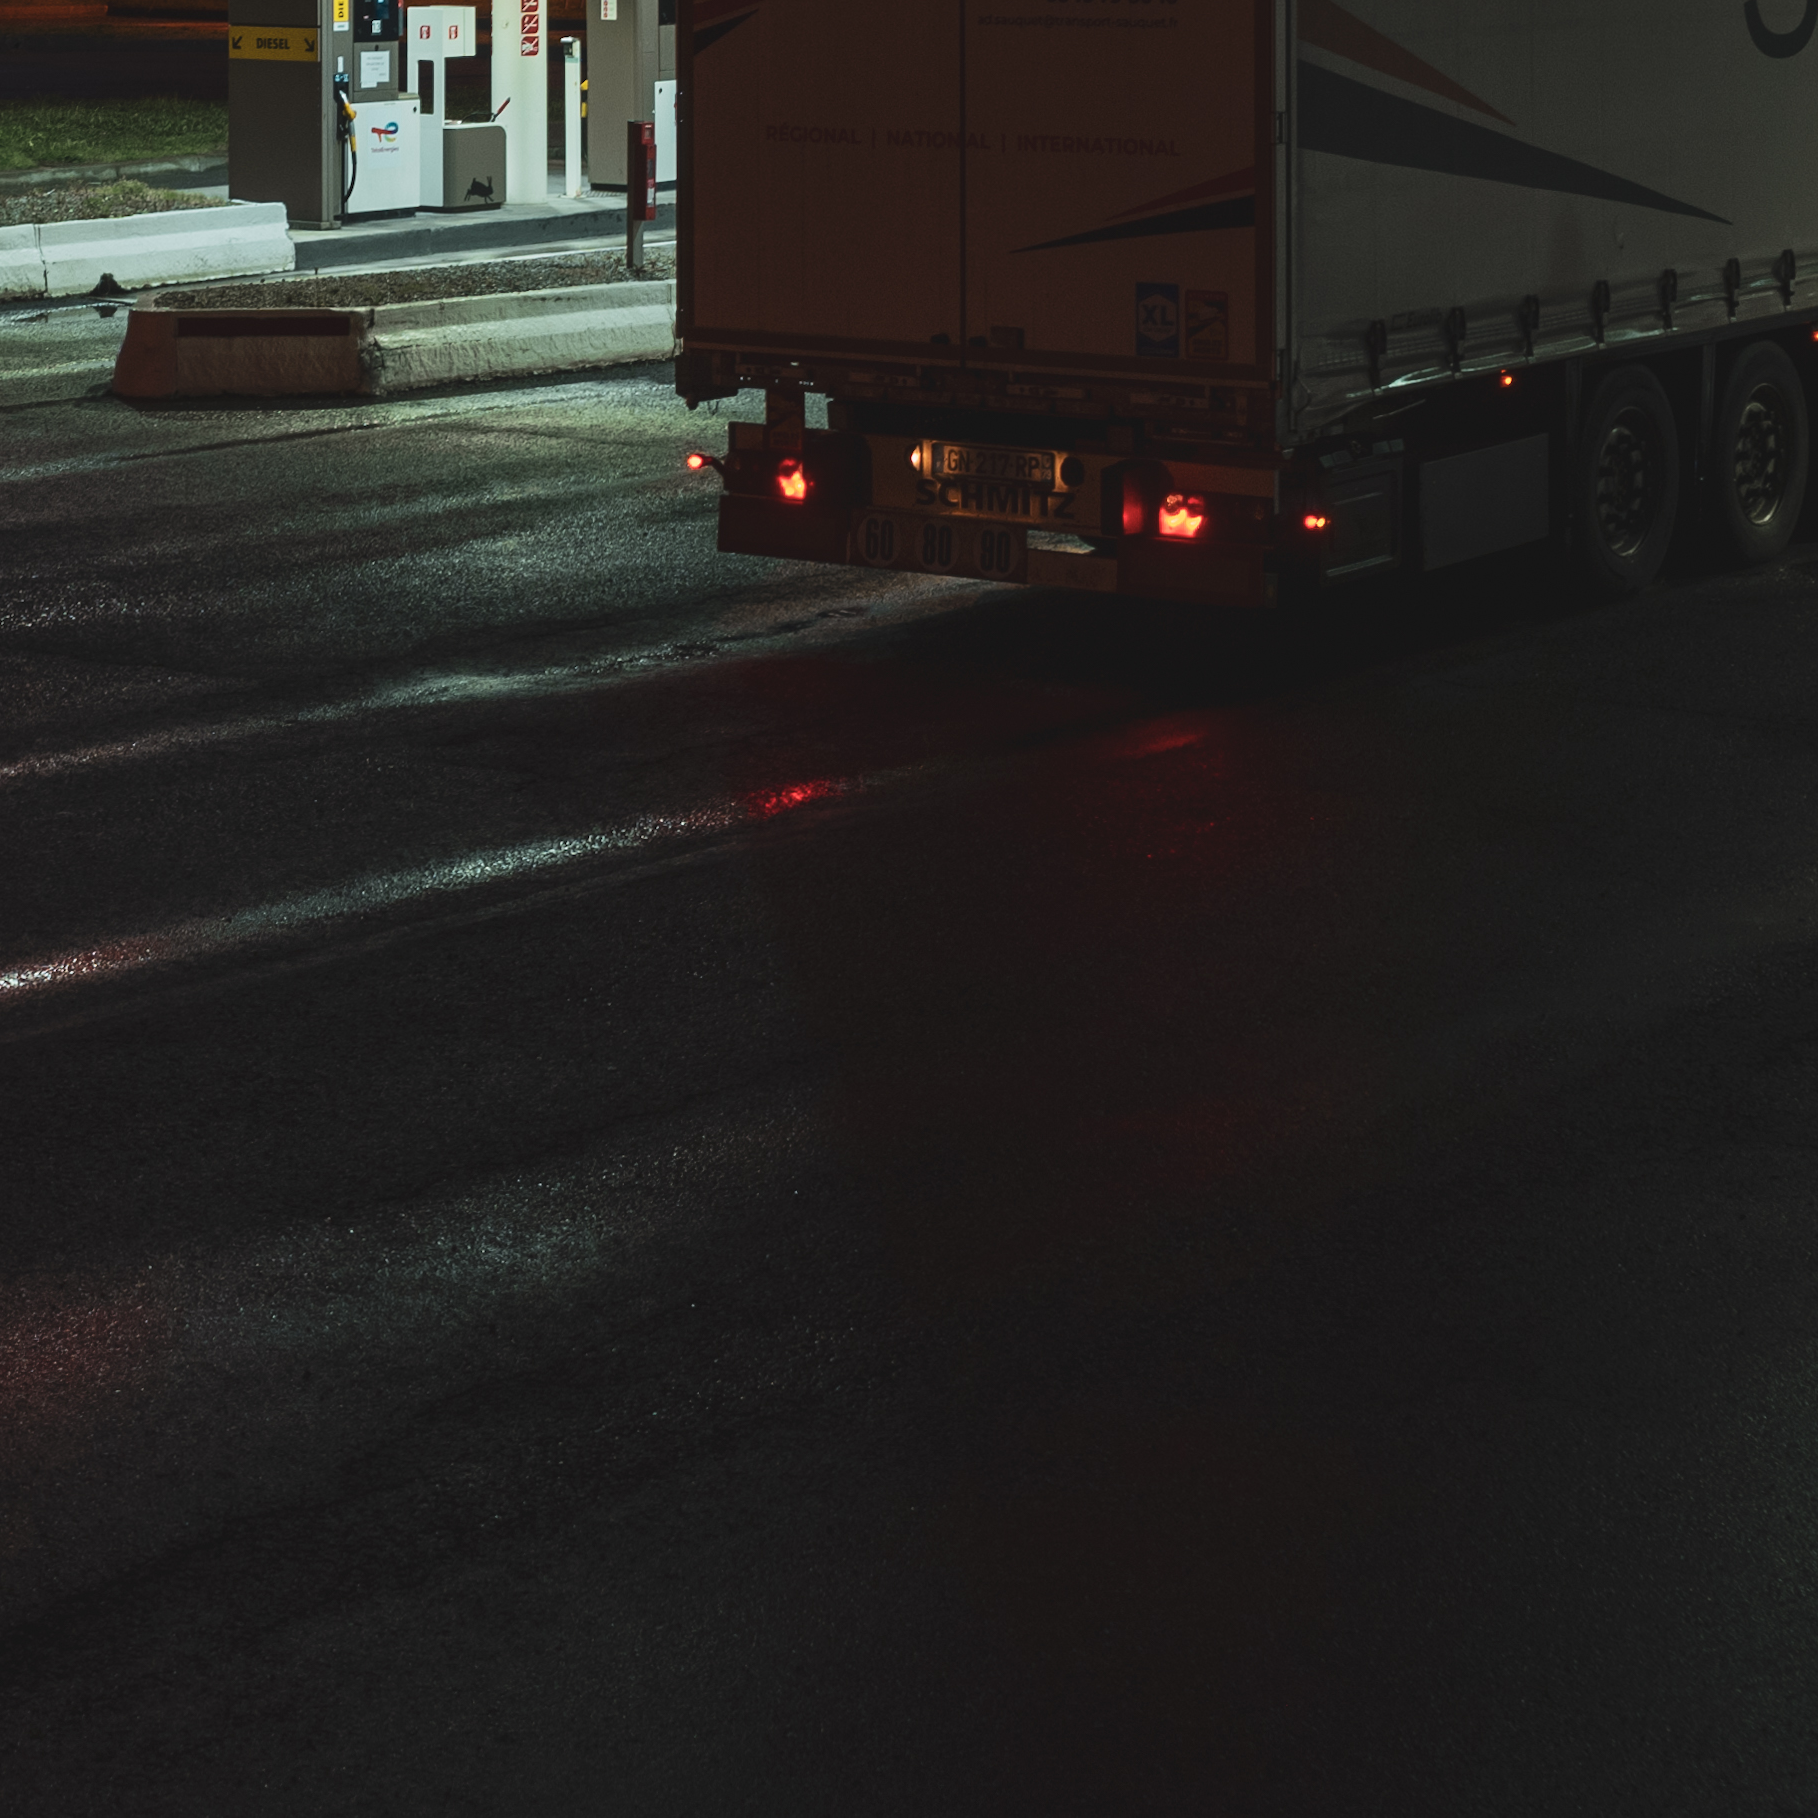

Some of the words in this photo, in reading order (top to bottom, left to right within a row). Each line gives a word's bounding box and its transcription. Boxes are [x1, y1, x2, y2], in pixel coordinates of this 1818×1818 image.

[256, 37, 291, 50] DIESEL
[765, 122, 862, 145] RÉGIONAL
[886, 129, 992, 151] NATIONAL
[1015, 134, 1182, 158] INTERNATIONAL
[1142, 304, 1175, 326] XL
[915, 479, 1076, 520] SCHMITZ
[865, 517, 894, 562] 60
[922, 523, 952, 568] 80
[980, 529, 1012, 574] 90
